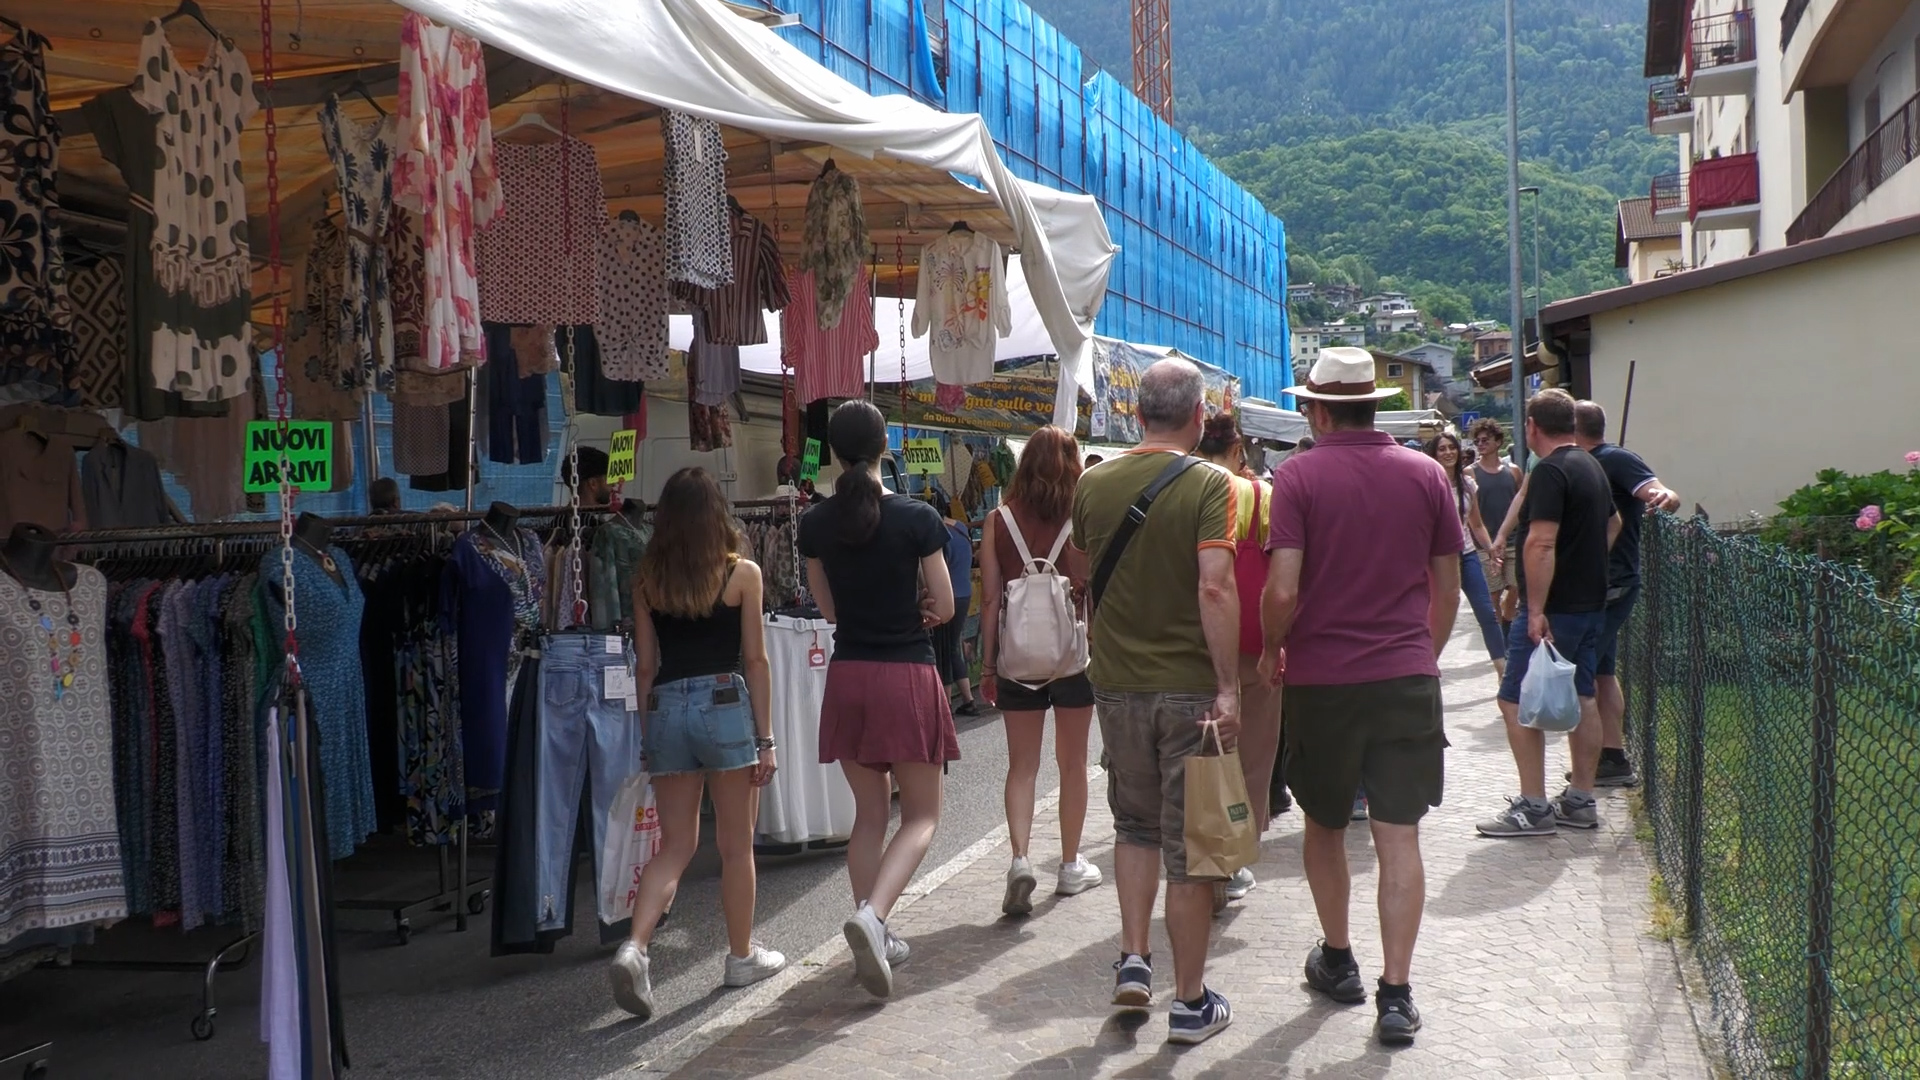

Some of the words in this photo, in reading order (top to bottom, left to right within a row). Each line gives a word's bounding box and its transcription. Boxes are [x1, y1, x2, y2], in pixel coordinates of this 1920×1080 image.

[997, 396, 1032, 412] sulle
[923, 411, 935, 421] da
[252, 427, 325, 452] NUOVI
[611, 434, 634, 454] NUOVI
[904, 446, 942, 464] OFFERTA
[248, 459, 327, 486] ARRIVI
[608, 458, 633, 479] ARRIVI
